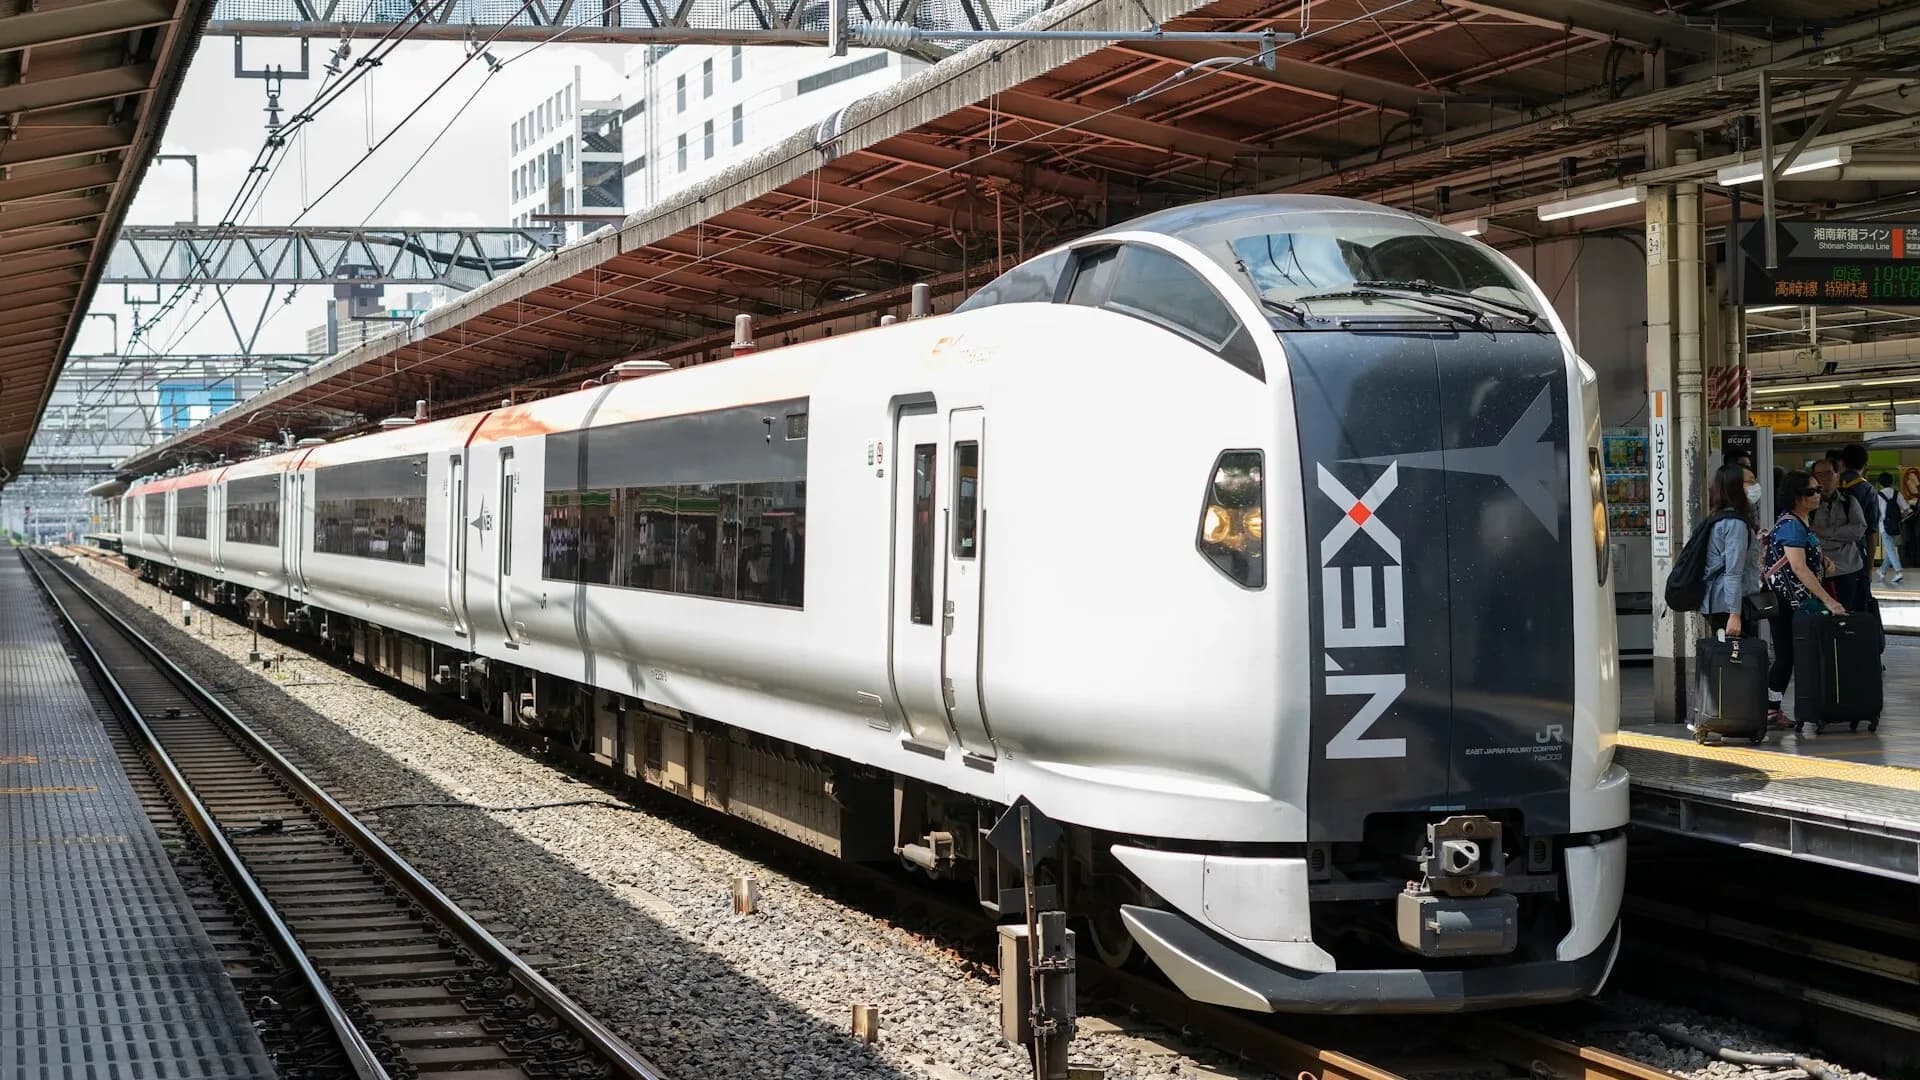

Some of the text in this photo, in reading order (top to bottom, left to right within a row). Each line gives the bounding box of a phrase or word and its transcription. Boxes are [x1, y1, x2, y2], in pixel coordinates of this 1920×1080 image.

[1814, 228, 1890, 241] 湘南新宿ライン
[1824, 281, 1868, 298] 特別快速
[1655, 423, 1665, 503] いけぶくろ
[1535, 724, 1563, 743] JR
